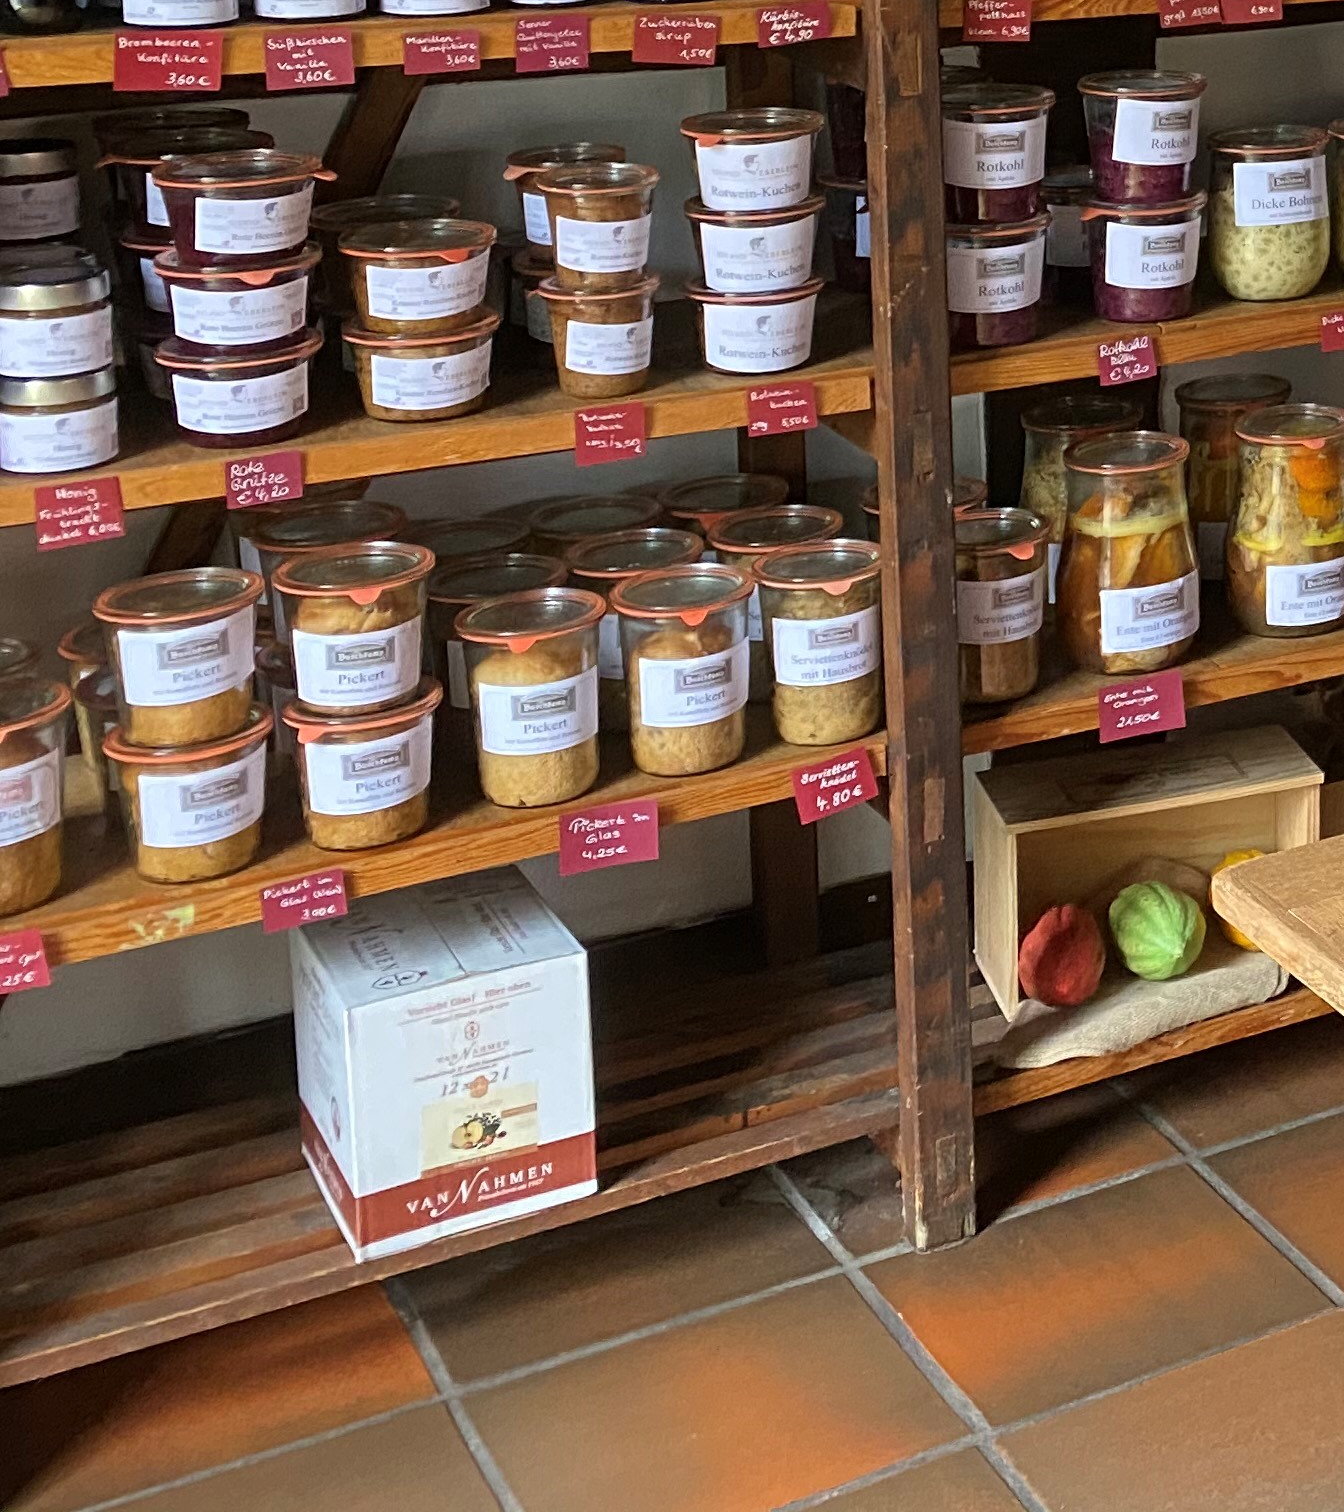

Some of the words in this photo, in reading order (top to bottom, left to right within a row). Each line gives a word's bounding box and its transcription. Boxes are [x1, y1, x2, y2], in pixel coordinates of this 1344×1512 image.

[1151, 136, 1192, 151] Rotkohl
[976, 159, 1025, 173] Rotkohl
[1250, 198, 1286, 211] Dicke
[1141, 258, 1185, 274] Rotkohl
[978, 279, 1025, 298] Rotkohl
[55, 487, 98, 502] Honig
[171, 663, 222, 683] Pickert
[337, 669, 386, 685] Pickert
[685, 688, 727, 708] Pickert
[522, 718, 568, 735] Pickert
[355, 773, 402, 795] Pickert
[193, 803, 241, 825] Pickert
[405, 1191, 450, 1215] VAN
[429, 1161, 554, 1218] NAHMEN
